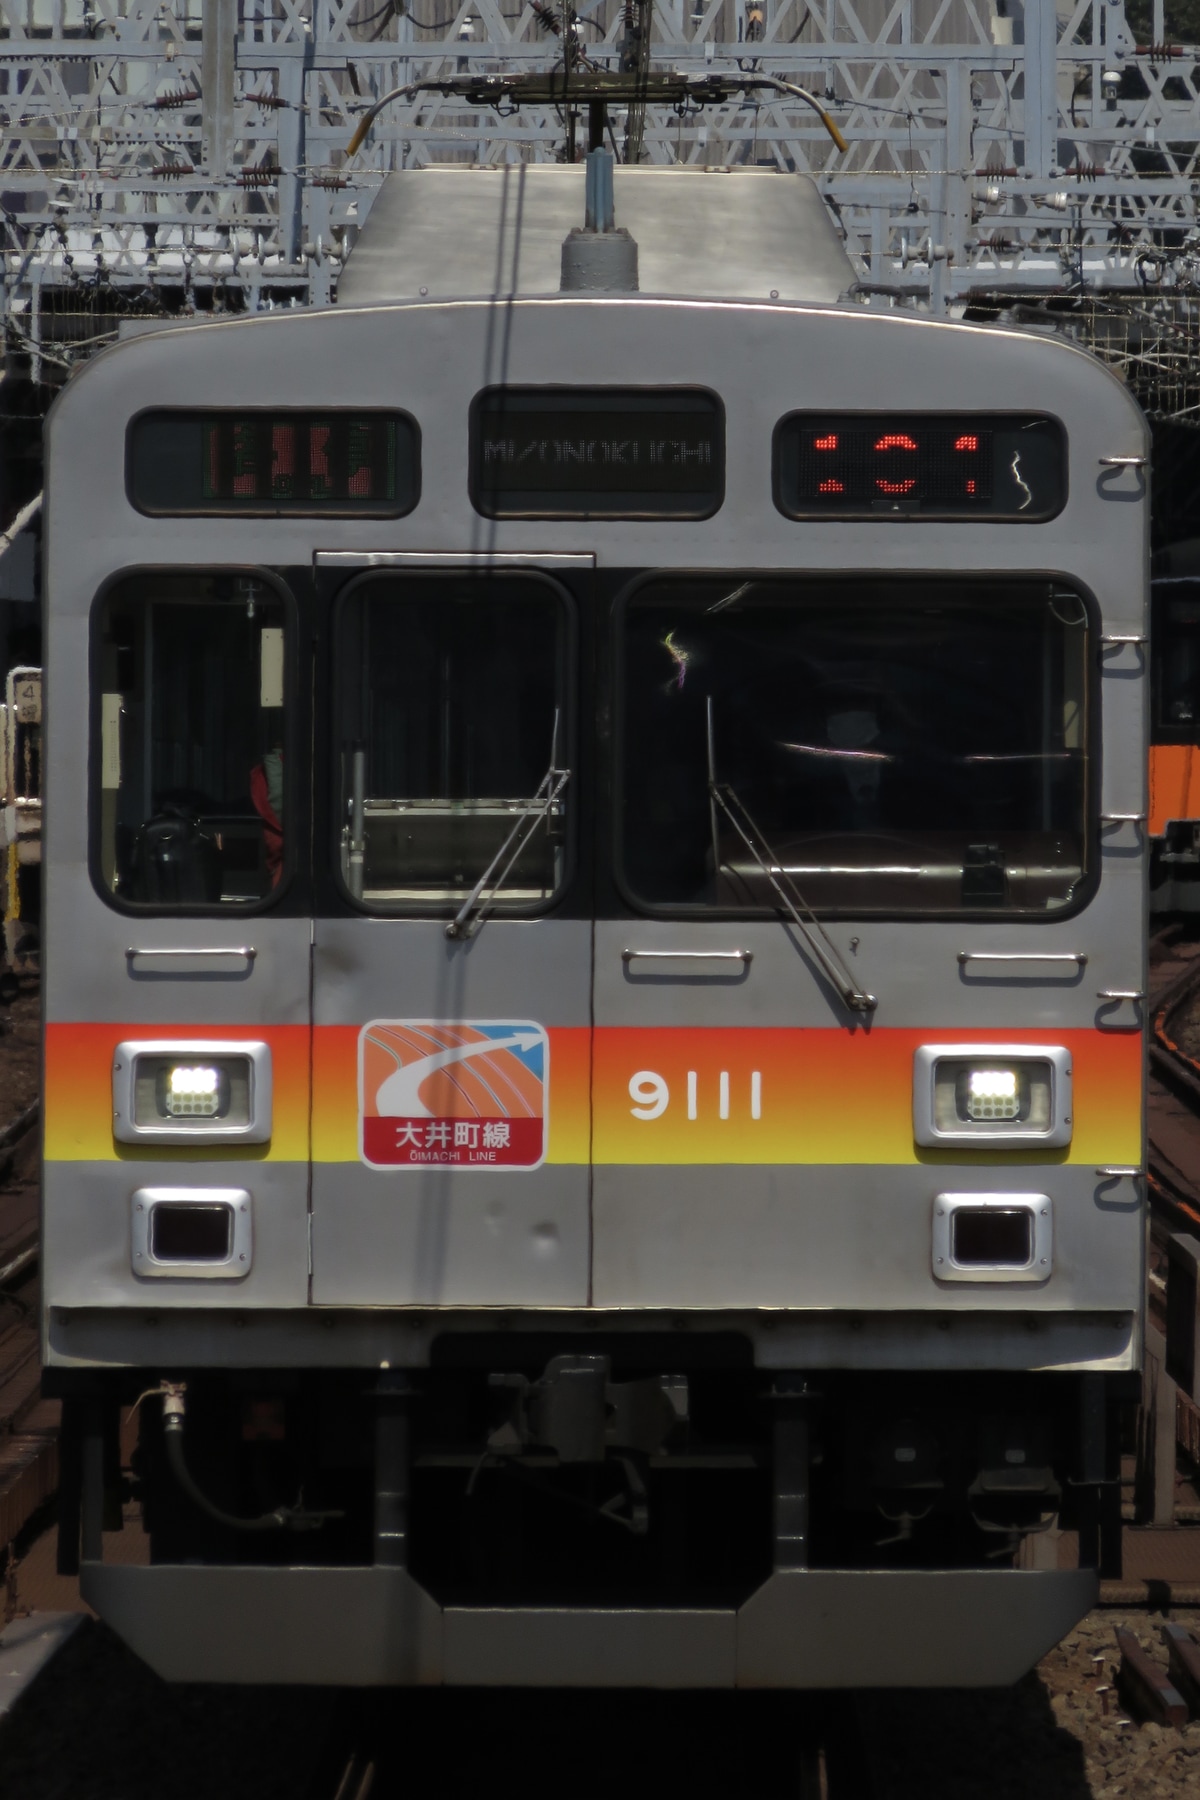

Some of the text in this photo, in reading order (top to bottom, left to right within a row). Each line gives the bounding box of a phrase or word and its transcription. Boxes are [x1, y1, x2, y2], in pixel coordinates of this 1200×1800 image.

[628, 1070, 762, 1121] 9111
[395, 1121, 511, 1149] 大井町線
[469, 1151, 497, 1161] LINE
